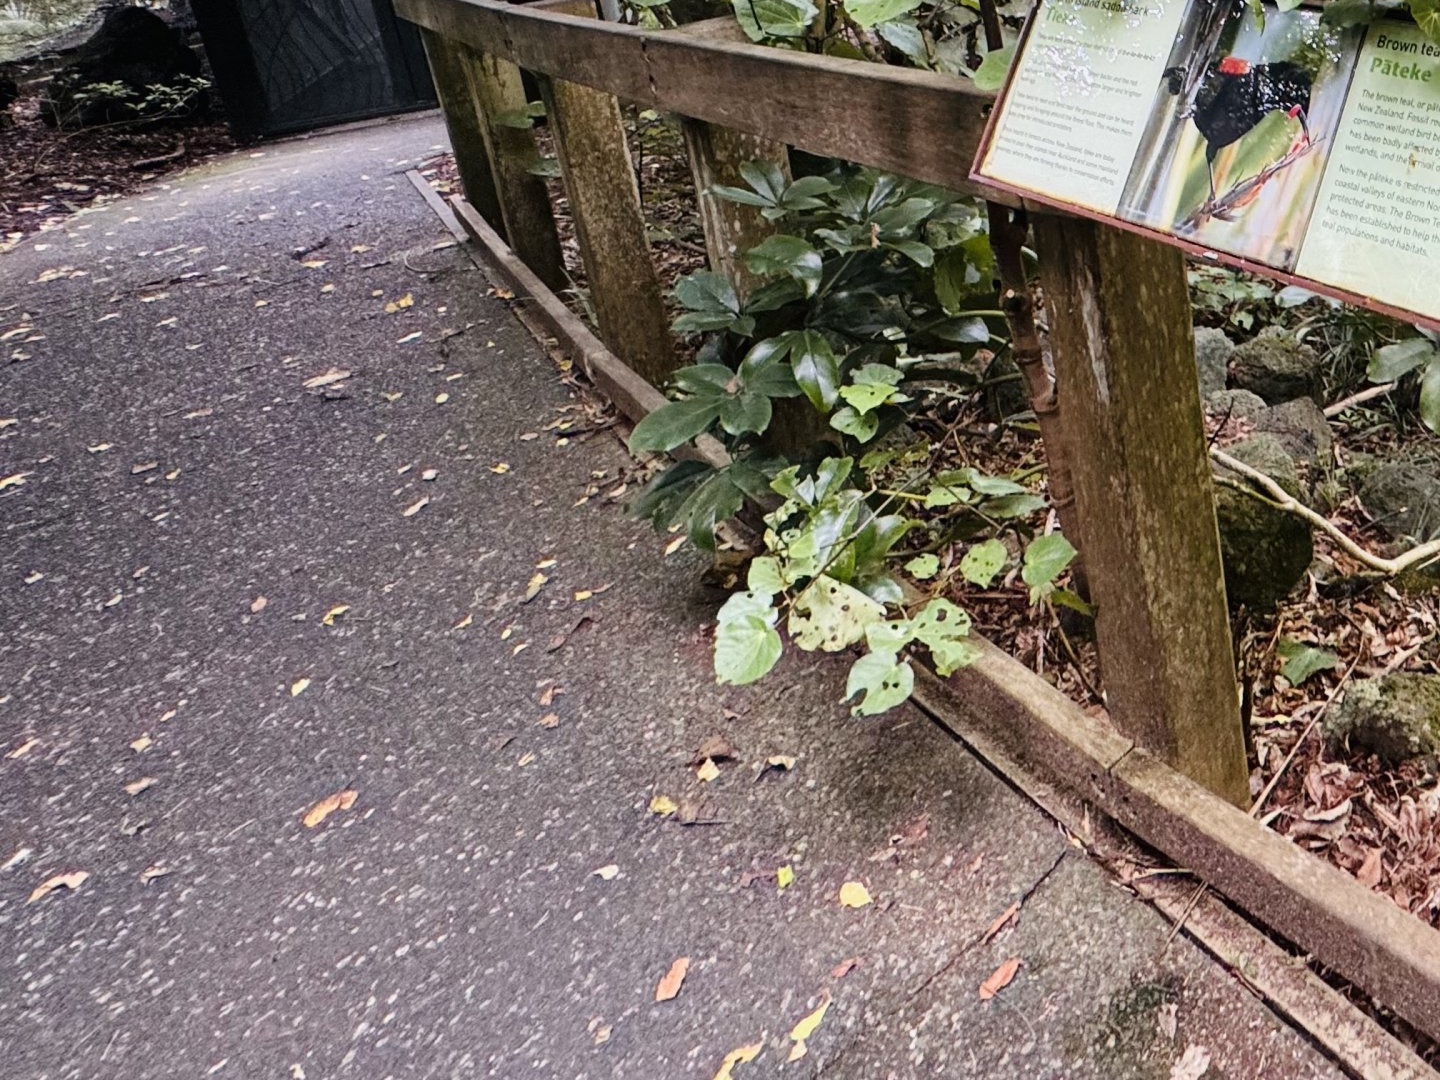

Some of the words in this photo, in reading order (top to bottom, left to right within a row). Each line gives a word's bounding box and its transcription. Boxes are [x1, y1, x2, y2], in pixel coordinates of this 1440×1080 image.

[1377, 34, 1419, 52] Brown
[1370, 56, 1434, 82] Pāteke
[1362, 89, 1374, 99] The
[1376, 92, 1397, 104] brown
[1417, 101, 1425, 109] or
[1357, 103, 1372, 113] New
[1407, 112, 1429, 124] Fossil
[1349, 129, 1362, 140] has
[1363, 133, 1381, 144] been
[1382, 137, 1401, 151] badly
[1353, 118, 1384, 130] common
[1385, 124, 1415, 136] wetland
[1416, 129, 1431, 140] bird
[1380, 152, 1394, 161] and
[1396, 154, 1407, 164] the
[1335, 179, 1360, 191] coastal
[1361, 185, 1386, 199] valleys
[1387, 191, 1395, 200] of
[1396, 195, 1424, 208] eastern
[1356, 168, 1368, 178] the
[1395, 177, 1402, 187] is
[1404, 181, 1440, 196] restricted
[1329, 193, 1364, 208] protected
[1389, 206, 1403, 218] The
[1405, 211, 1430, 225] Brown
[1326, 205, 1339, 216] has
[1341, 208, 1358, 221] been
[1359, 215, 1402, 233] established
[1403, 225, 1410, 235] to
[1412, 228, 1430, 243] help
[1321, 219, 1336, 230] teal
[1336, 225, 1378, 243] populations
[1380, 237, 1394, 247] and
[1395, 239, 1427, 257] habitats.
